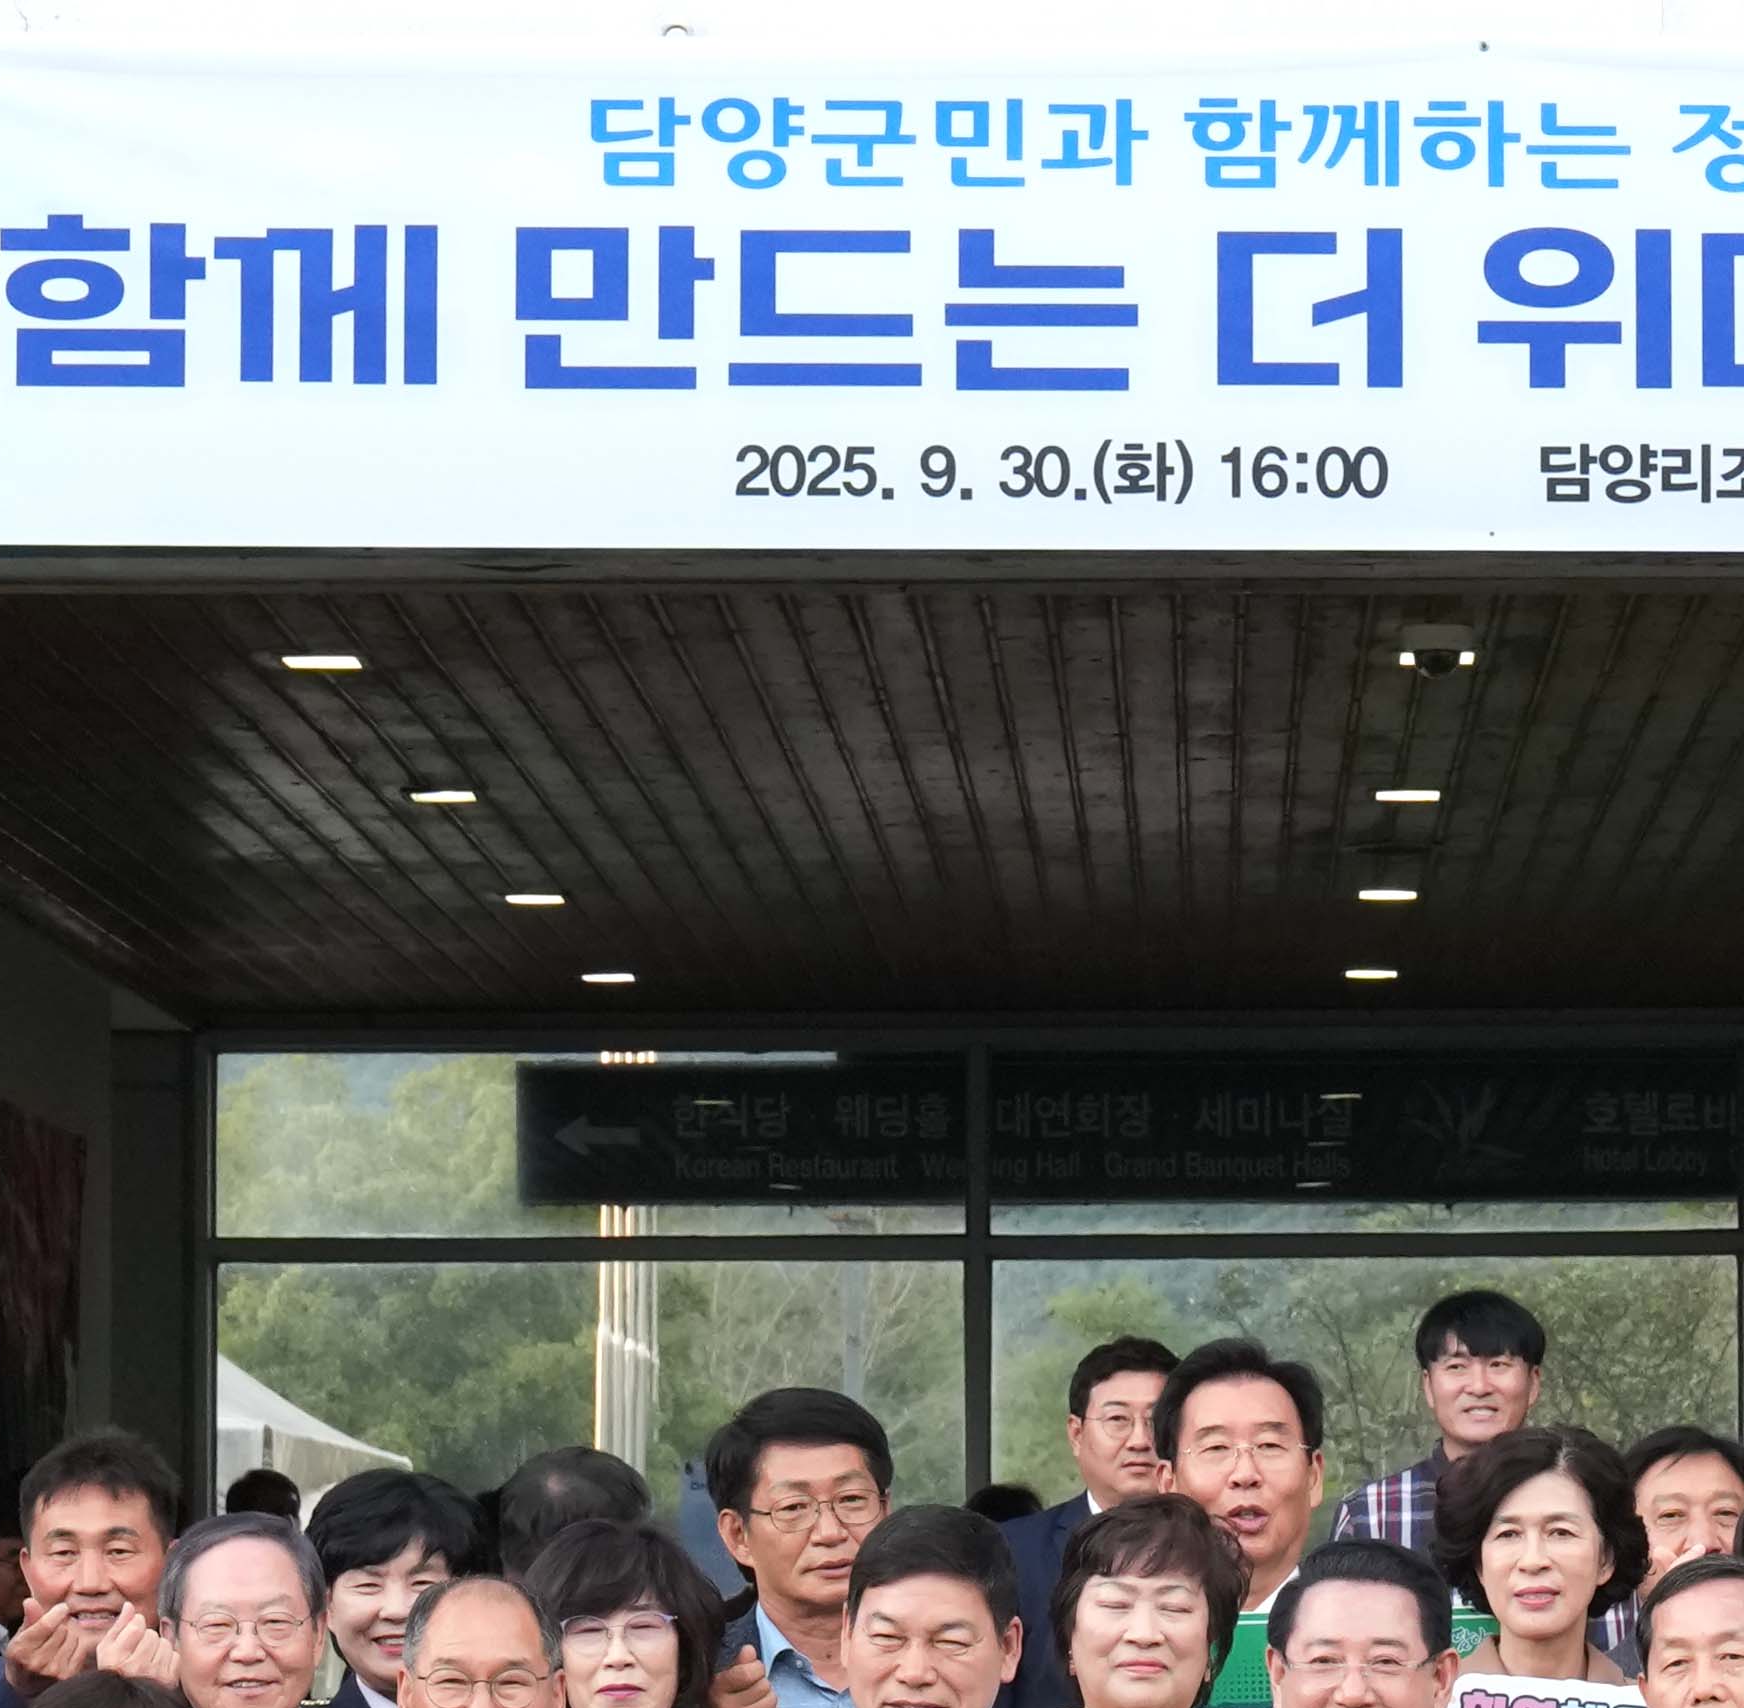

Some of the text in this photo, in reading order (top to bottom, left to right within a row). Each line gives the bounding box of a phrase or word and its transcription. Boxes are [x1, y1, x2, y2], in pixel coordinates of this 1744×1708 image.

[591, 97, 1147, 189] 담양군민과
[1184, 98, 1630, 189] 함께하는
[1, 214, 439, 389] 함께
[515, 228, 1138, 391] 만드는
[1218, 230, 1402, 388] 더
[735, 444, 894, 499] 2025.
[920, 445, 972, 500] 9.
[999, 439, 1193, 504] 30.(화)
[1221, 446, 1389, 499] 16:00
